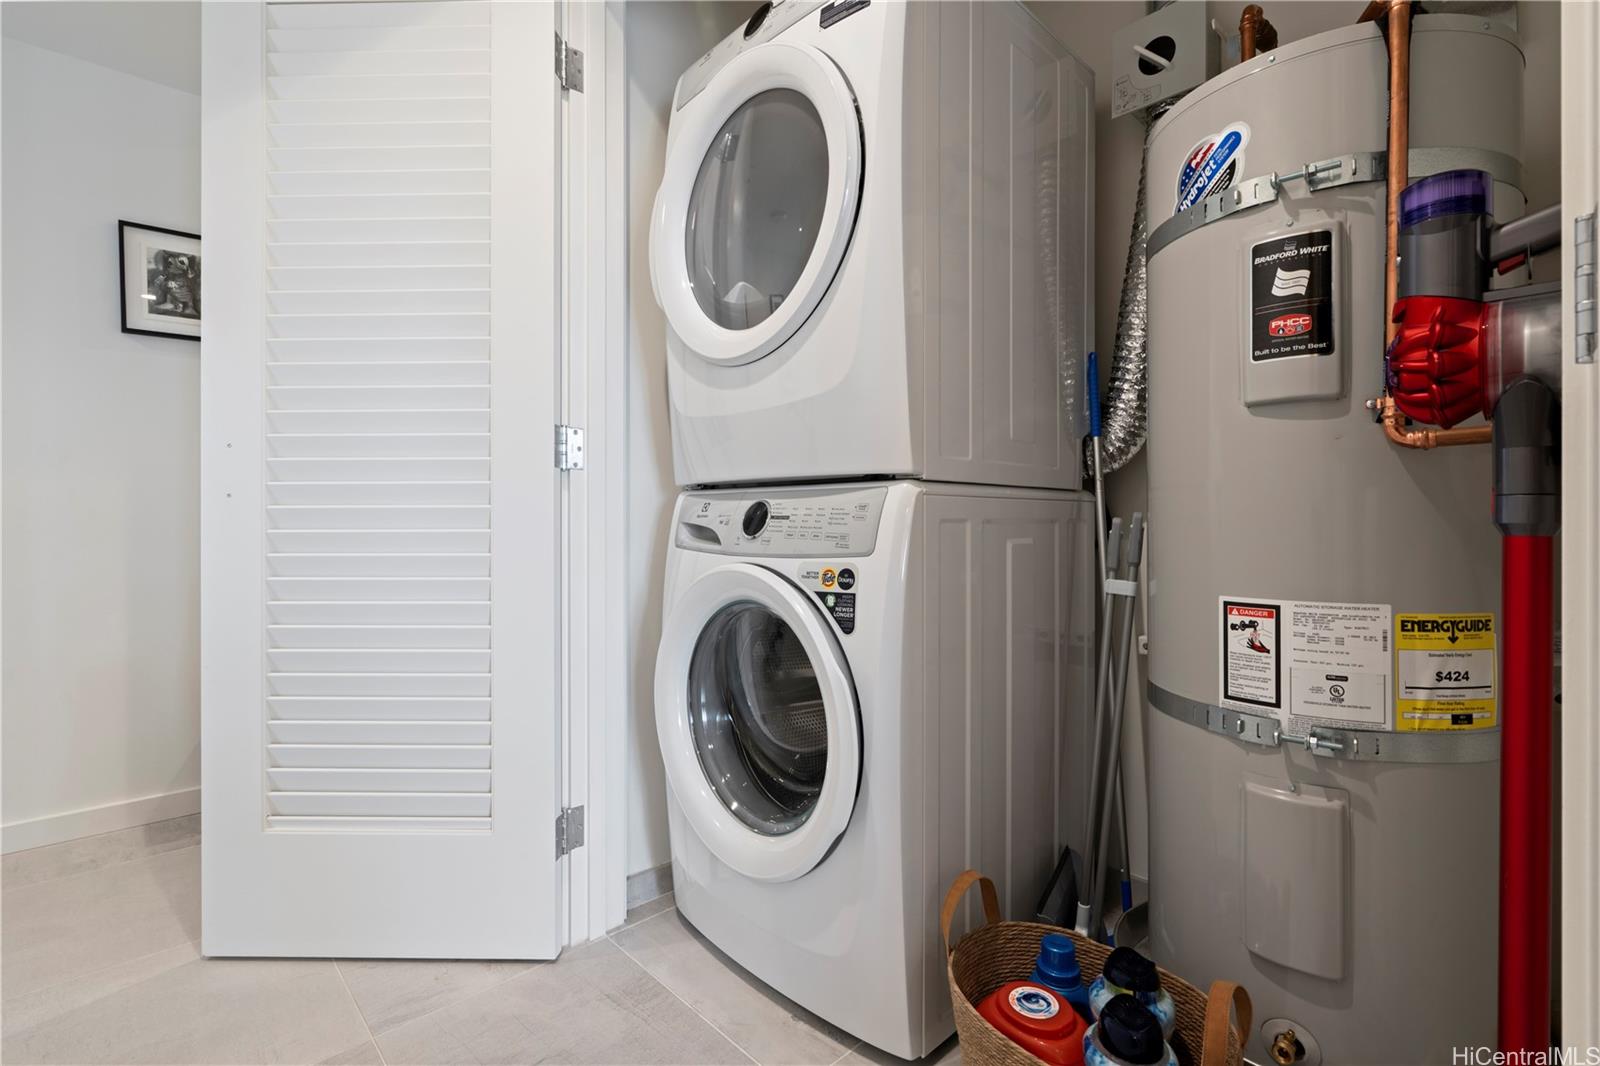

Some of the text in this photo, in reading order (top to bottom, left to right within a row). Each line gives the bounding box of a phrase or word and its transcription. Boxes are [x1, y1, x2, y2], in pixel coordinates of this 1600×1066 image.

[1180, 159, 1217, 211] Hydrojet
[1254, 250, 1298, 265] BRADFORD
[1299, 245, 1329, 255] WHITE
[1271, 316, 1310, 328] PHCC
[1254, 348, 1270, 356] Built
[1239, 609, 1269, 617] DANGER
[1400, 619, 1492, 635] ENERGYGUIDE
[1435, 670, 1470, 683] $424
